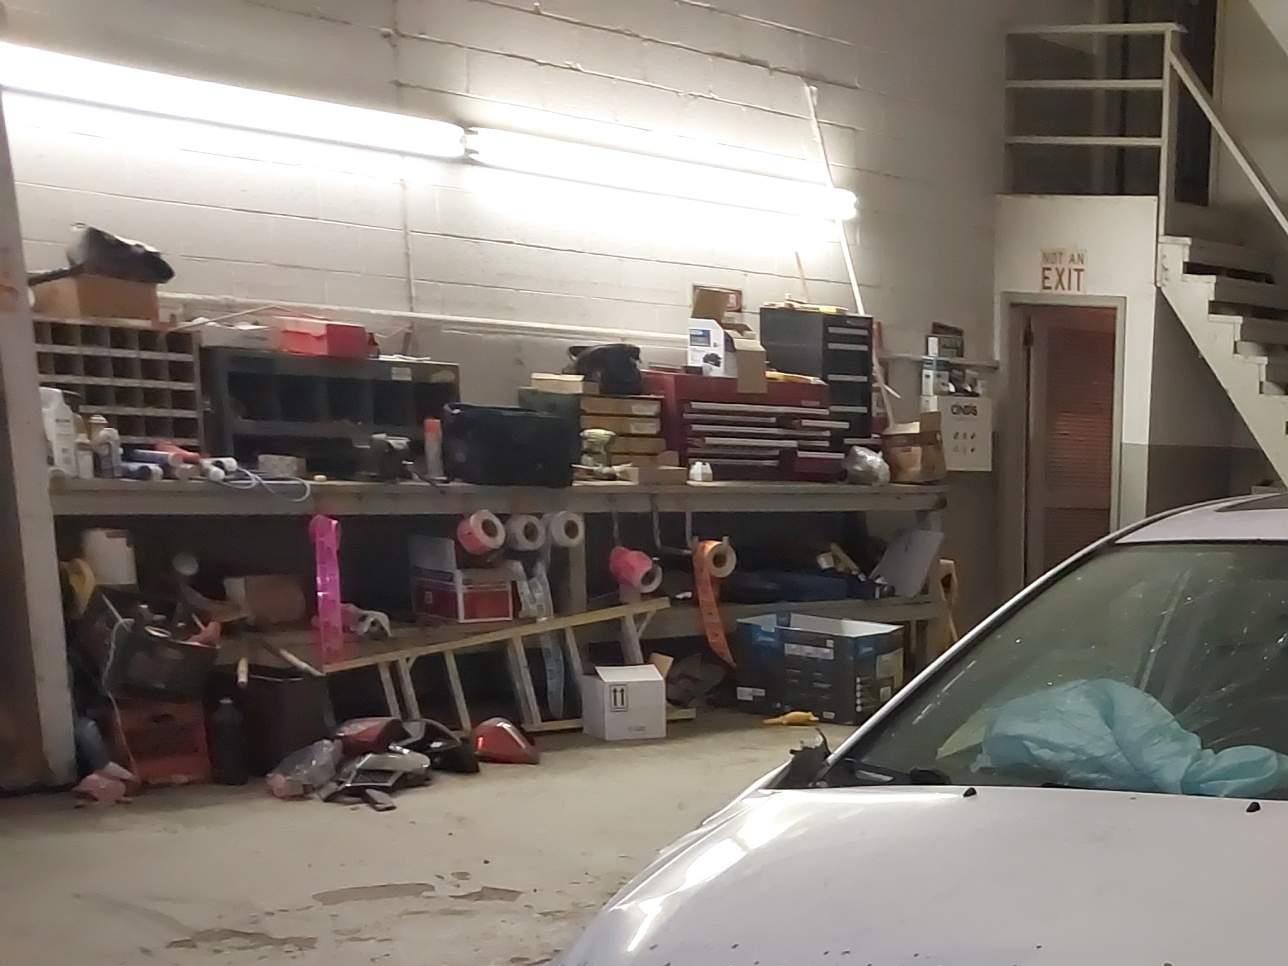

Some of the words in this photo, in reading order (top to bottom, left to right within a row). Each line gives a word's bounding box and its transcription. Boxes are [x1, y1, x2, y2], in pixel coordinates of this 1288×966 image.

[1042, 252, 1064, 265] NOT
[1069, 253, 1085, 265] AN
[1042, 267, 1085, 292] EXIT
